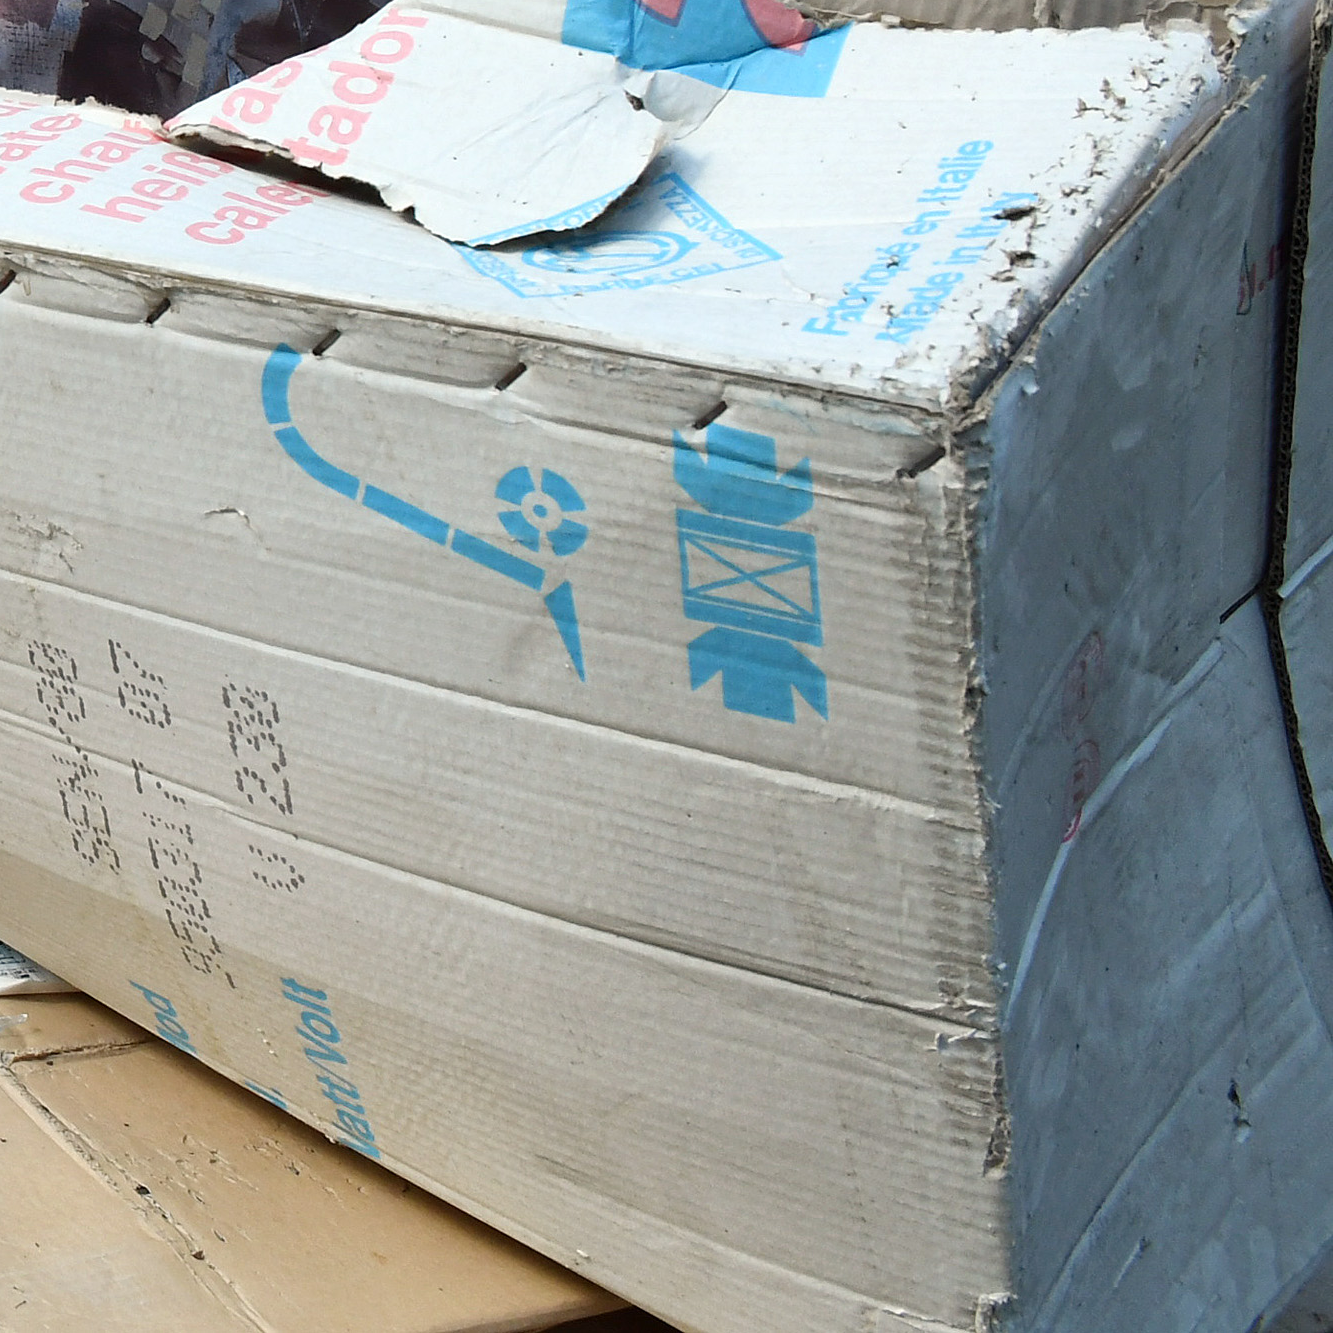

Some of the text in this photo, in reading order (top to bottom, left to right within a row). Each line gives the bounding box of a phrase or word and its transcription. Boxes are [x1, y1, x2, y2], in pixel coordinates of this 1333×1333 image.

[916, 139, 994, 203] Italie
[901, 210, 952, 236] en
[874, 271, 965, 345] Made
[933, 245, 987, 266] in
